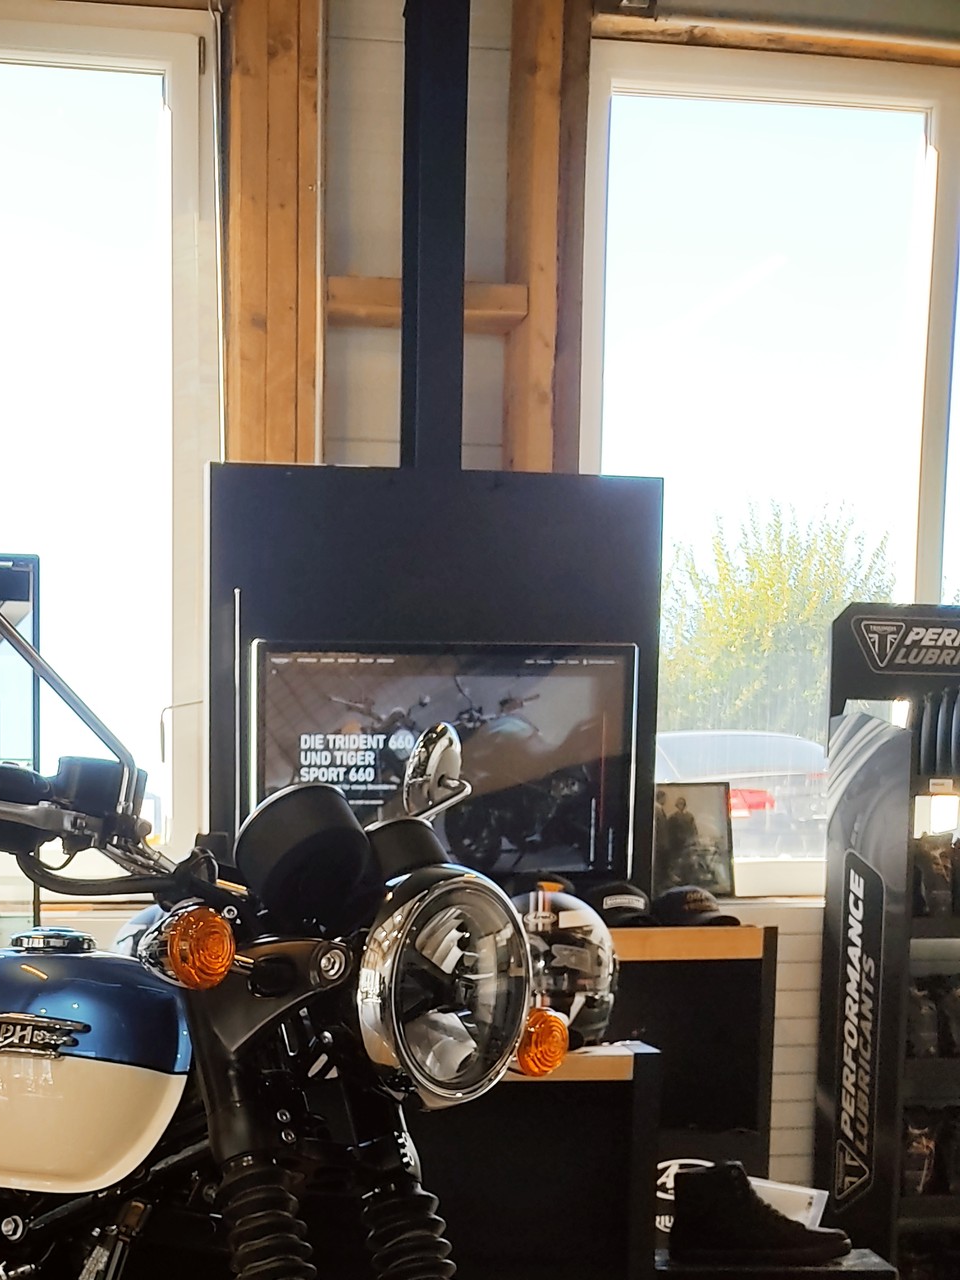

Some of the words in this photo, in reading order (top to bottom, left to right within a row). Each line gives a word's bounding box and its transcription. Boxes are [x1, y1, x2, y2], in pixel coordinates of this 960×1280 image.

[300, 734, 325, 750] DIE
[326, 734, 387, 750] TRIDENT
[388, 734, 415, 750] 660
[300, 750, 332, 766] UND
[333, 750, 375, 766] TIGER
[300, 766, 347, 782] SPORT
[348, 766, 375, 782] 660
[840, 868, 865, 1141] PERFORMANCE
[855, 953, 876, 1156] LUBRICANTS
